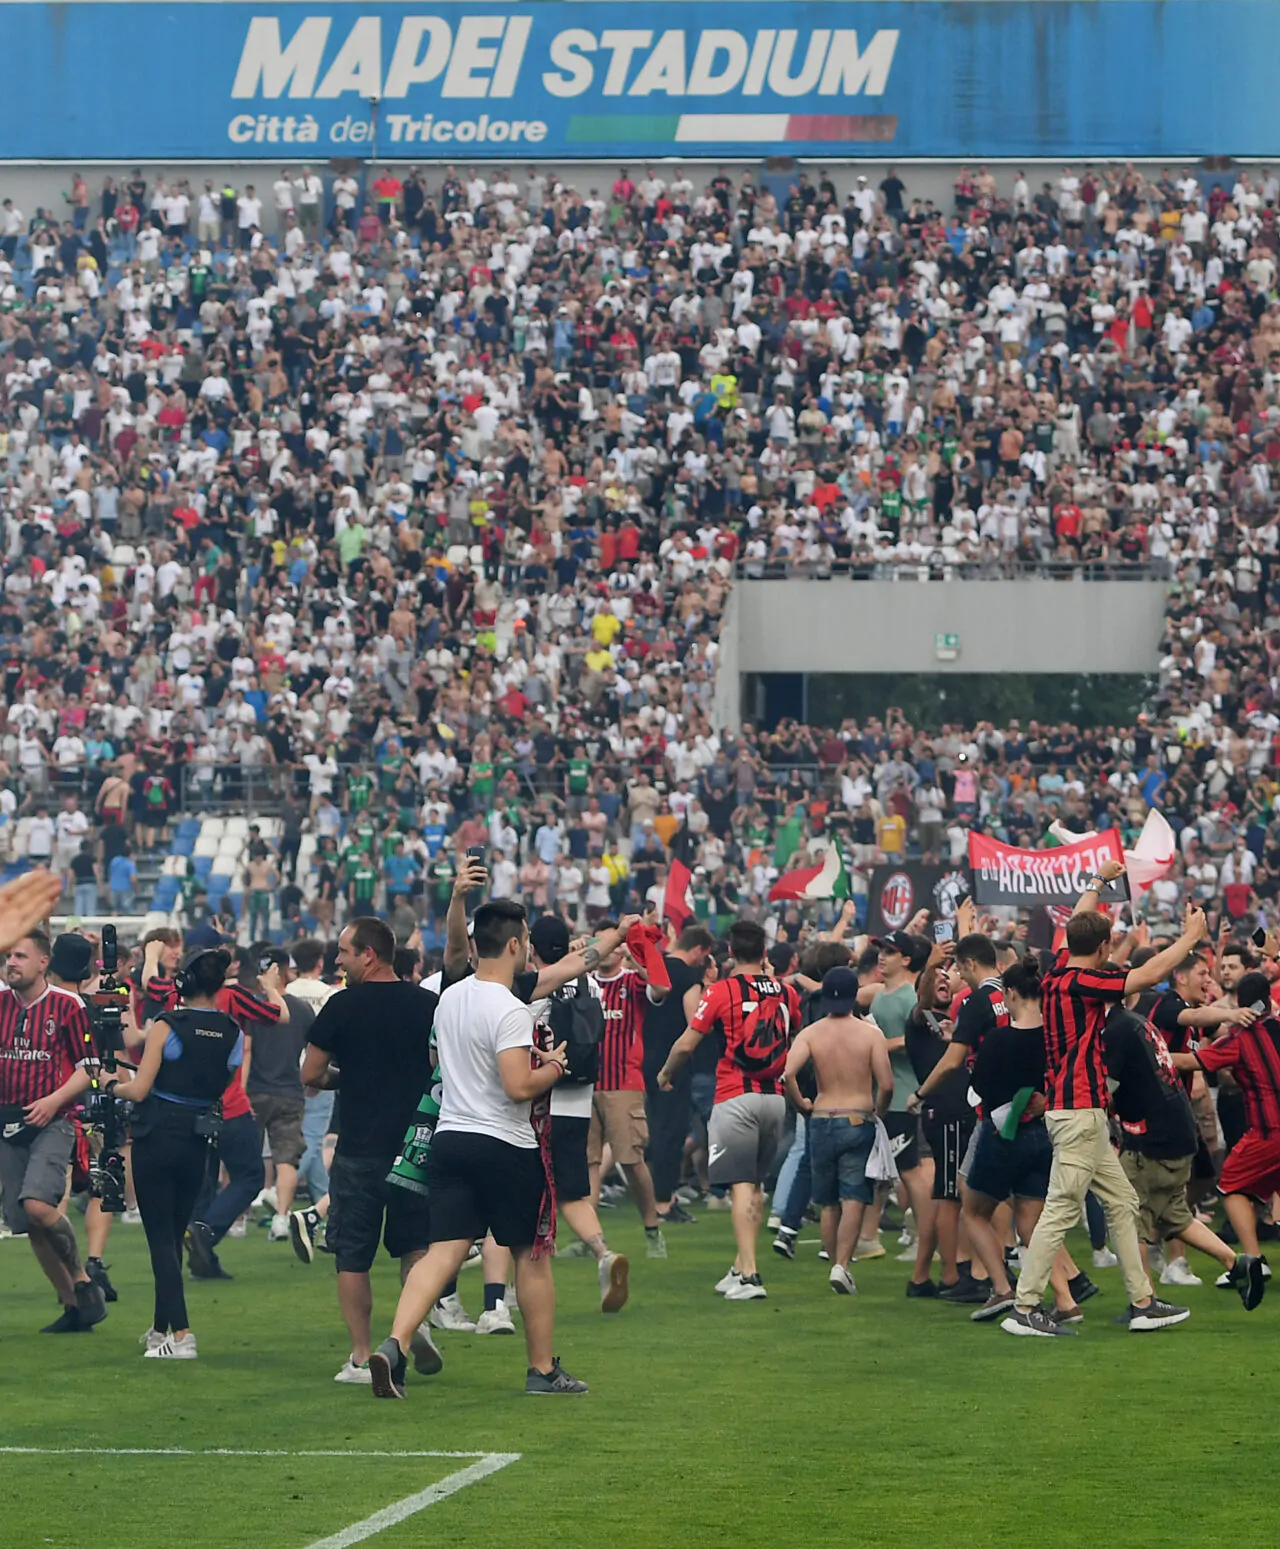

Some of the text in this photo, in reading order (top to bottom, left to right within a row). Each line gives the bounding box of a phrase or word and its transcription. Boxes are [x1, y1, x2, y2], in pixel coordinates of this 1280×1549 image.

[231, 16, 899, 98] MAPEI STADIUM
[228, 114, 319, 143] Città
[386, 114, 547, 142] Tricolore
